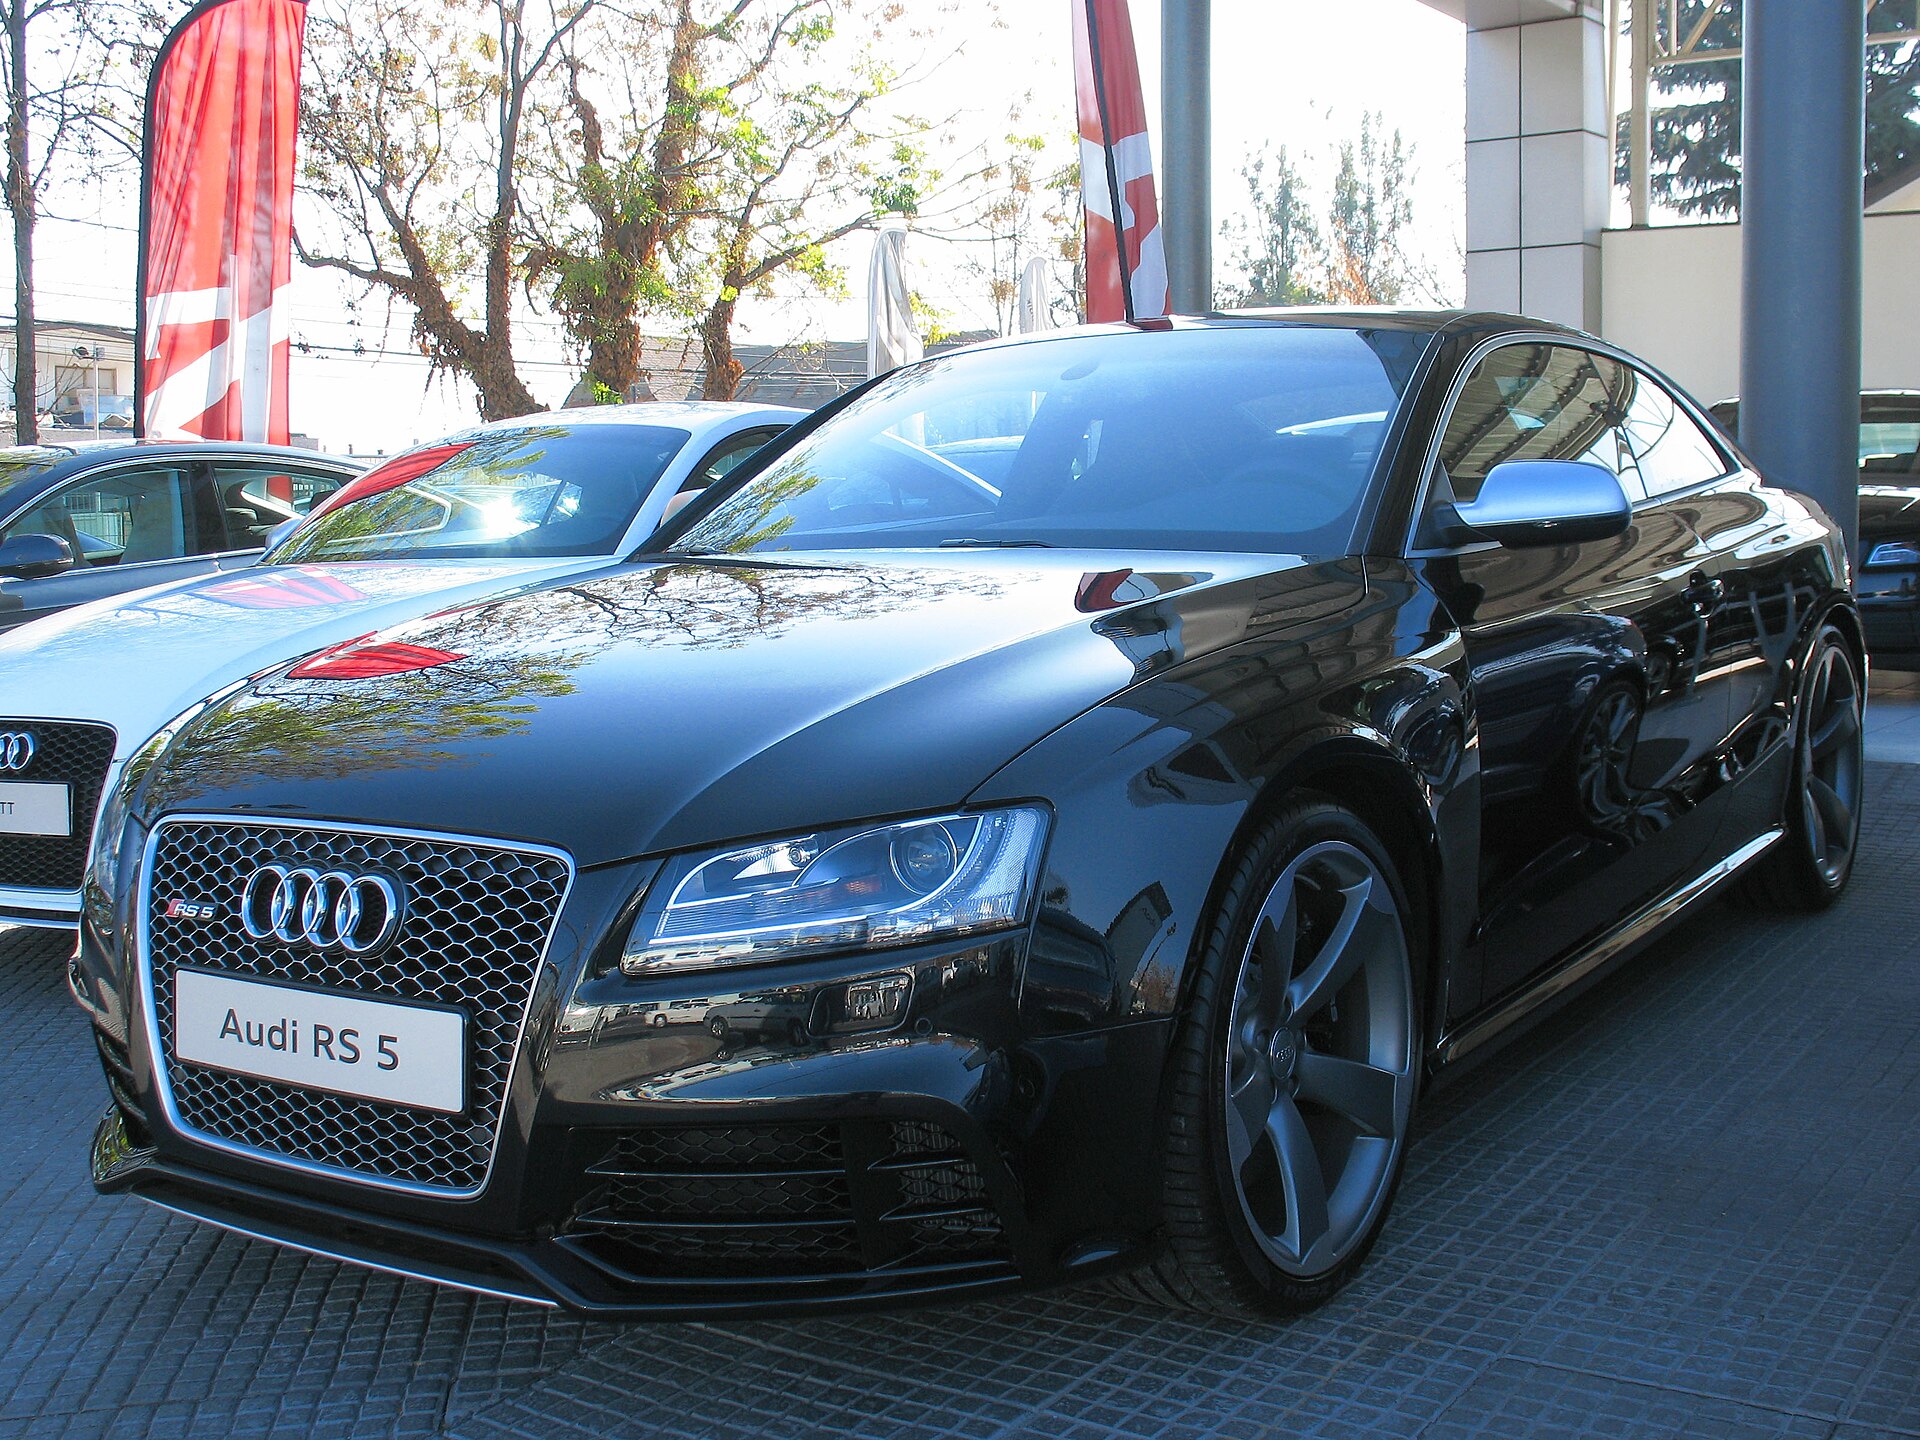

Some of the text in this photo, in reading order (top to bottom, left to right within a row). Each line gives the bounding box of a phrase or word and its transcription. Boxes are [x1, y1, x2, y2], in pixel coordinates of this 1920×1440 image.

[219, 1008, 400, 1071] Audi RS 5
